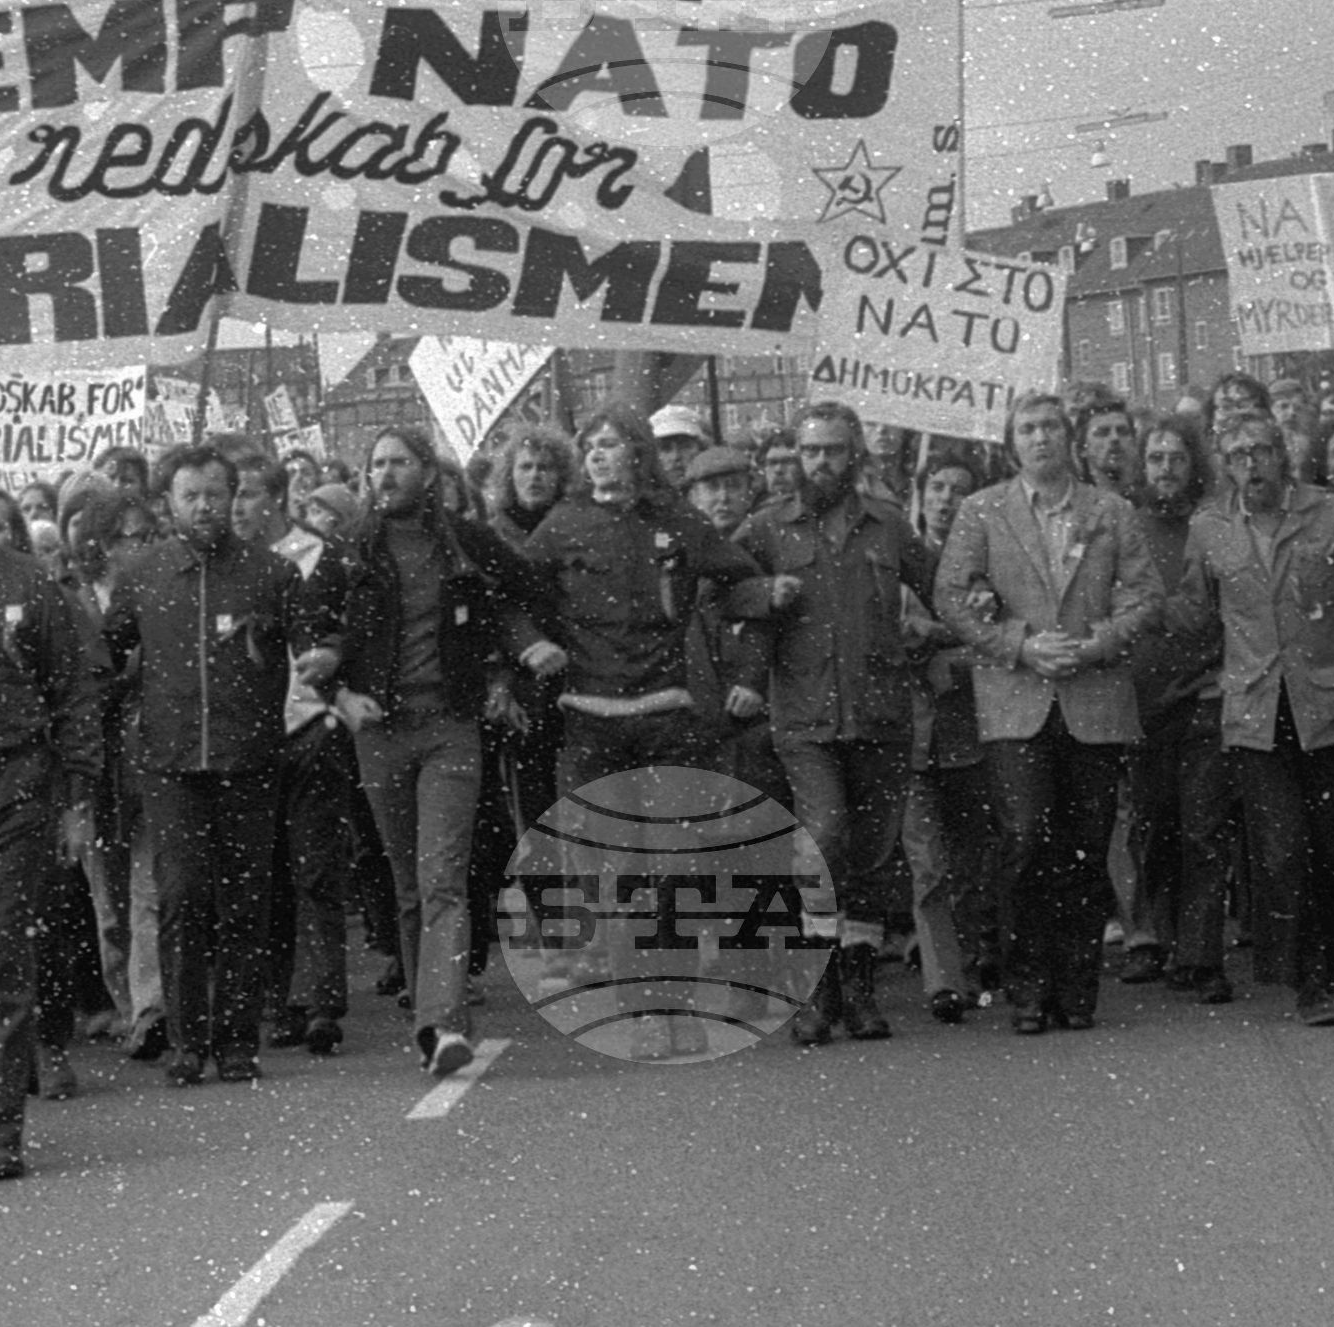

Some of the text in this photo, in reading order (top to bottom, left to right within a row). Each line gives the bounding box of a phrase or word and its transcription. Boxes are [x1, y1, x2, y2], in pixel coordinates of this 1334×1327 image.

[368, 6, 899, 121] NATO
[8, 91, 460, 201] redskab
[440, 116, 638, 211] for
[1289, 269, 1327, 291] OG
